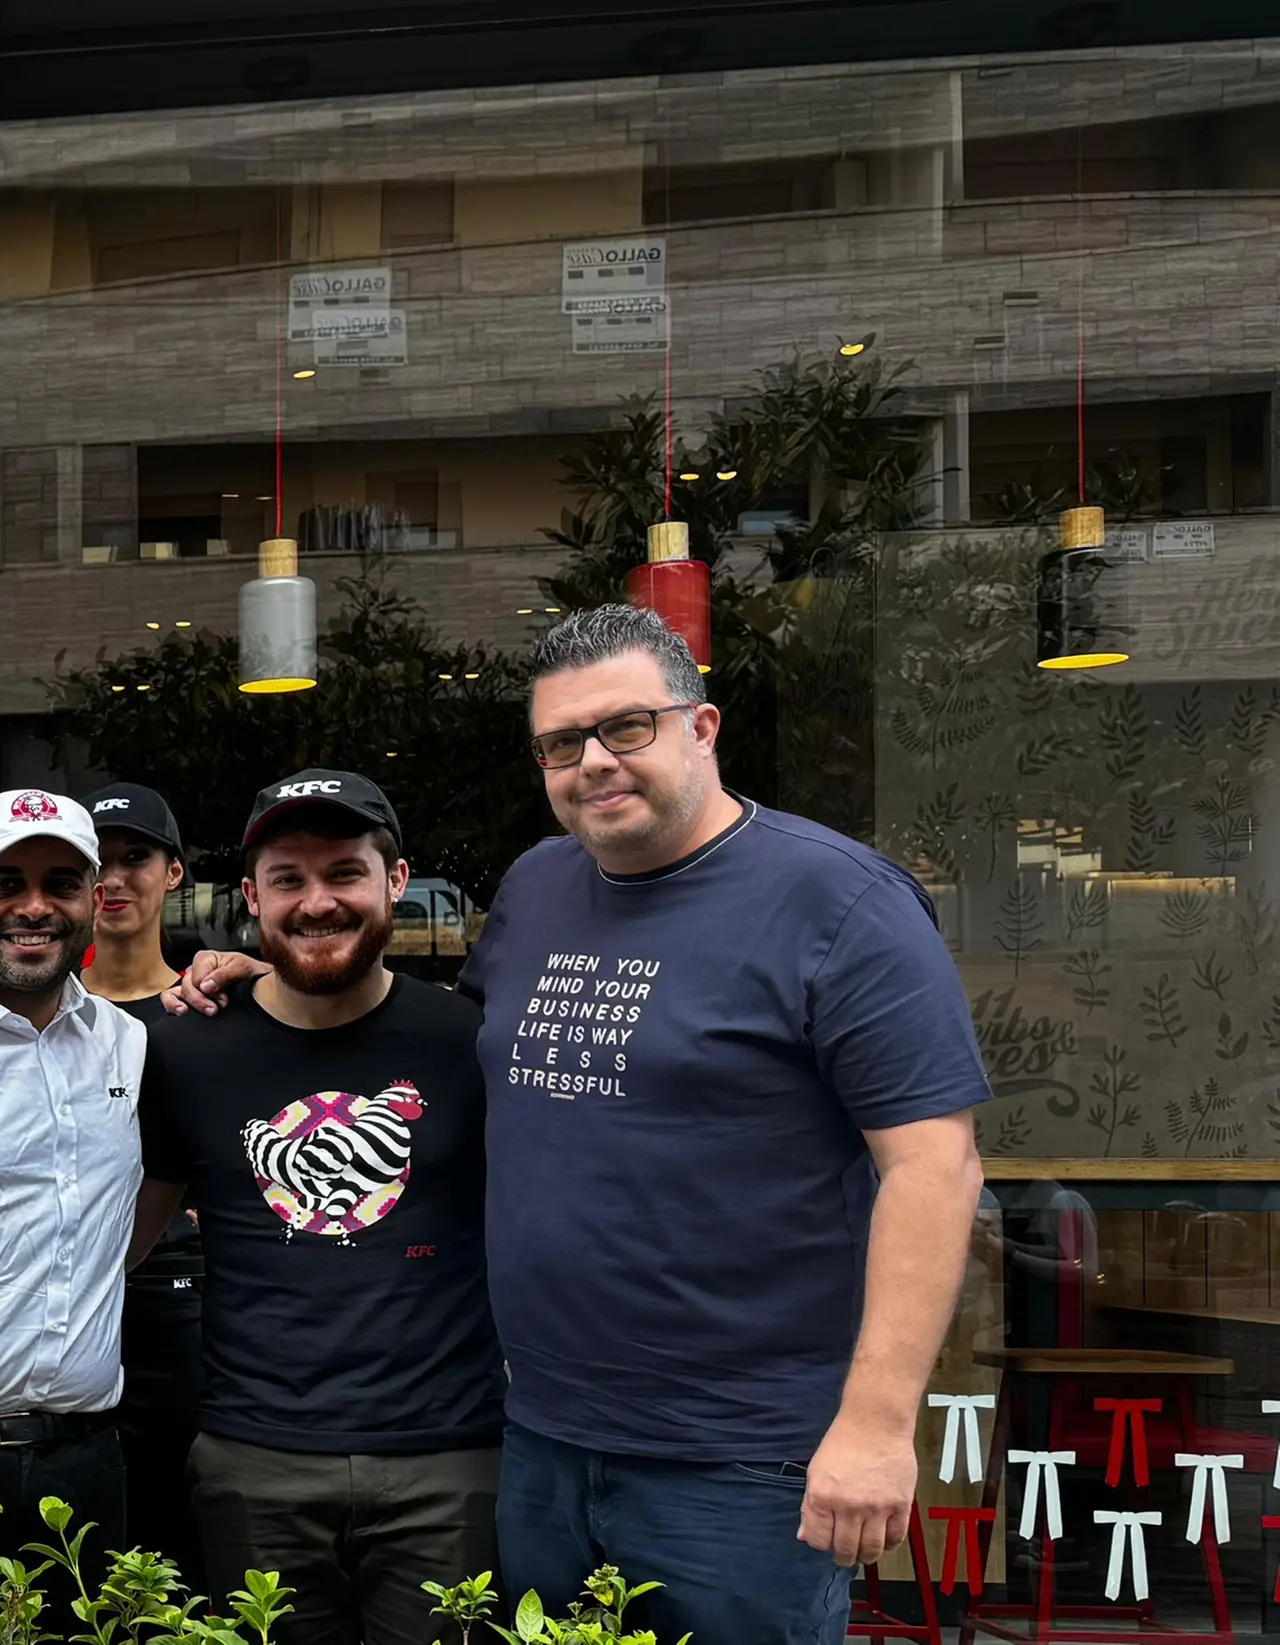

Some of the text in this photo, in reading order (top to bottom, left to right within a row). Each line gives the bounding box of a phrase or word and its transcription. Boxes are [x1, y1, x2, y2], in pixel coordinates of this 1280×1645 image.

[276, 780, 342, 798] KFC
[92, 798, 130, 814] KFC
[547, 953, 660, 977] WHEN YOU
[537, 975, 651, 1000] MIND YOUR
[527, 998, 641, 1022] BUSINESS
[518, 1020, 633, 1046] LIFE IS WAY
[508, 1067, 626, 1097] STRESSFUL
[404, 1244, 436, 1259] KFC
[173, 1277, 192, 1289] KFC
